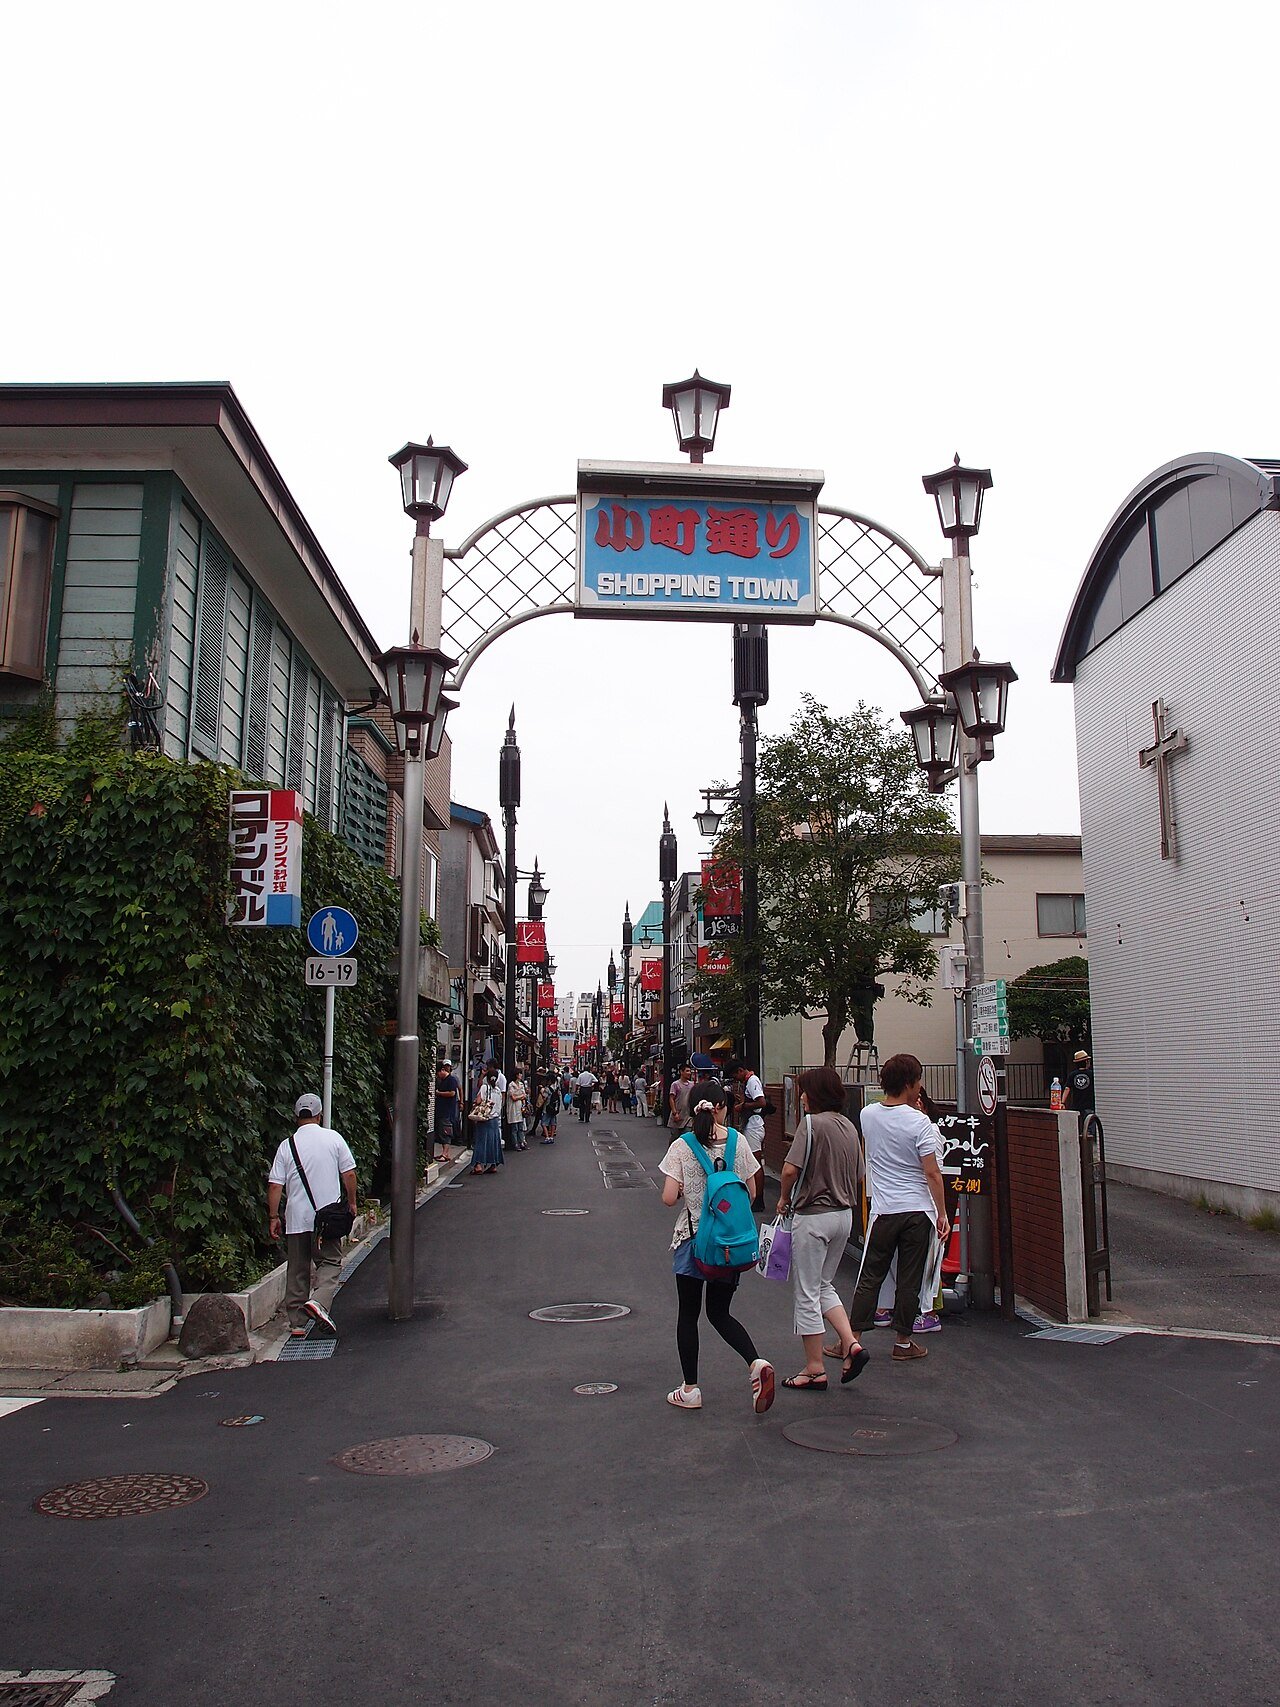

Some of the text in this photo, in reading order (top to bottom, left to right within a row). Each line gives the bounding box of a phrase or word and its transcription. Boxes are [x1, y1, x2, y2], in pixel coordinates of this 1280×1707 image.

[595, 503, 801, 559] 小町通り
[597, 572, 799, 602] SHOPPING TOWN
[272, 821, 289, 893] フランス料理
[309, 963, 353, 981] 16-19
[962, 1156, 985, 1169] 二階
[950, 1176, 981, 1194] 右側
